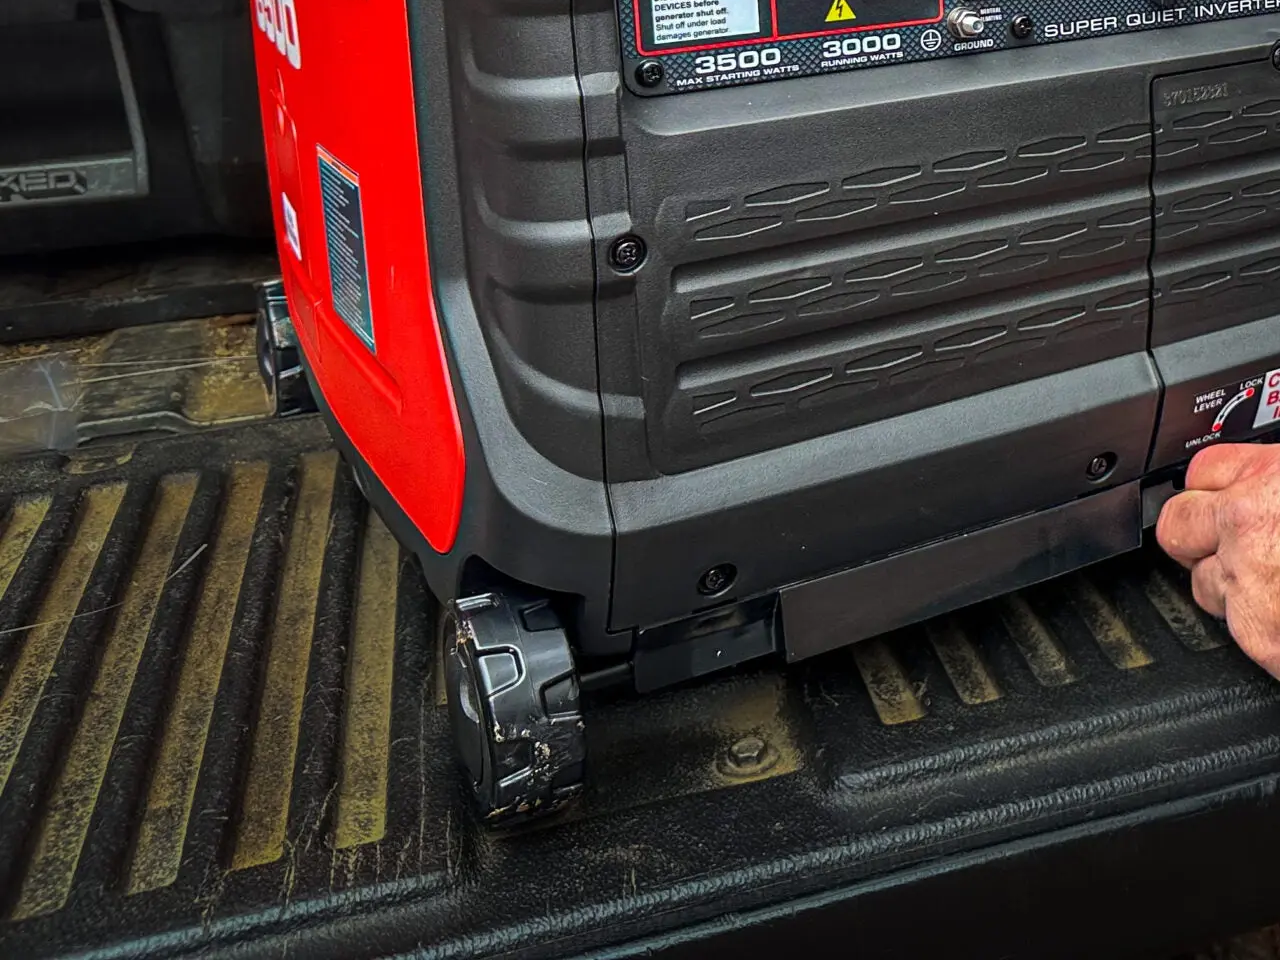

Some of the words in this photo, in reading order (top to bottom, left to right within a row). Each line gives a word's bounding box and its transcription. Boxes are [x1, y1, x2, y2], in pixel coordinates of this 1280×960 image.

[654, 1, 692, 12] DEVICES
[694, 0, 719, 8] before
[655, 12, 694, 22] generator
[696, 9, 714, 17] shut
[1044, 16, 1118, 38] SUPER
[1126, 7, 1187, 26] QUIET
[655, 23, 674, 31] Shut
[687, 20, 708, 28] under
[710, 17, 727, 25] load
[656, 32, 692, 41] damages
[822, 33, 901, 58] 3000
[954, 39, 994, 51] GROUND
[695, 48, 781, 74] 3500
[820, 56, 868, 68] RUNNING
[869, 51, 904, 62] WATTS
[676, 76, 703, 87] MAX
[706, 69, 761, 83] STARTING
[763, 64, 800, 76] WATTS
[1239, 377, 1265, 391] LOCK
[1195, 389, 1227, 404] WHEEL
[1193, 398, 1223, 413] LEVER
[1185, 431, 1222, 448] UNLOCK
